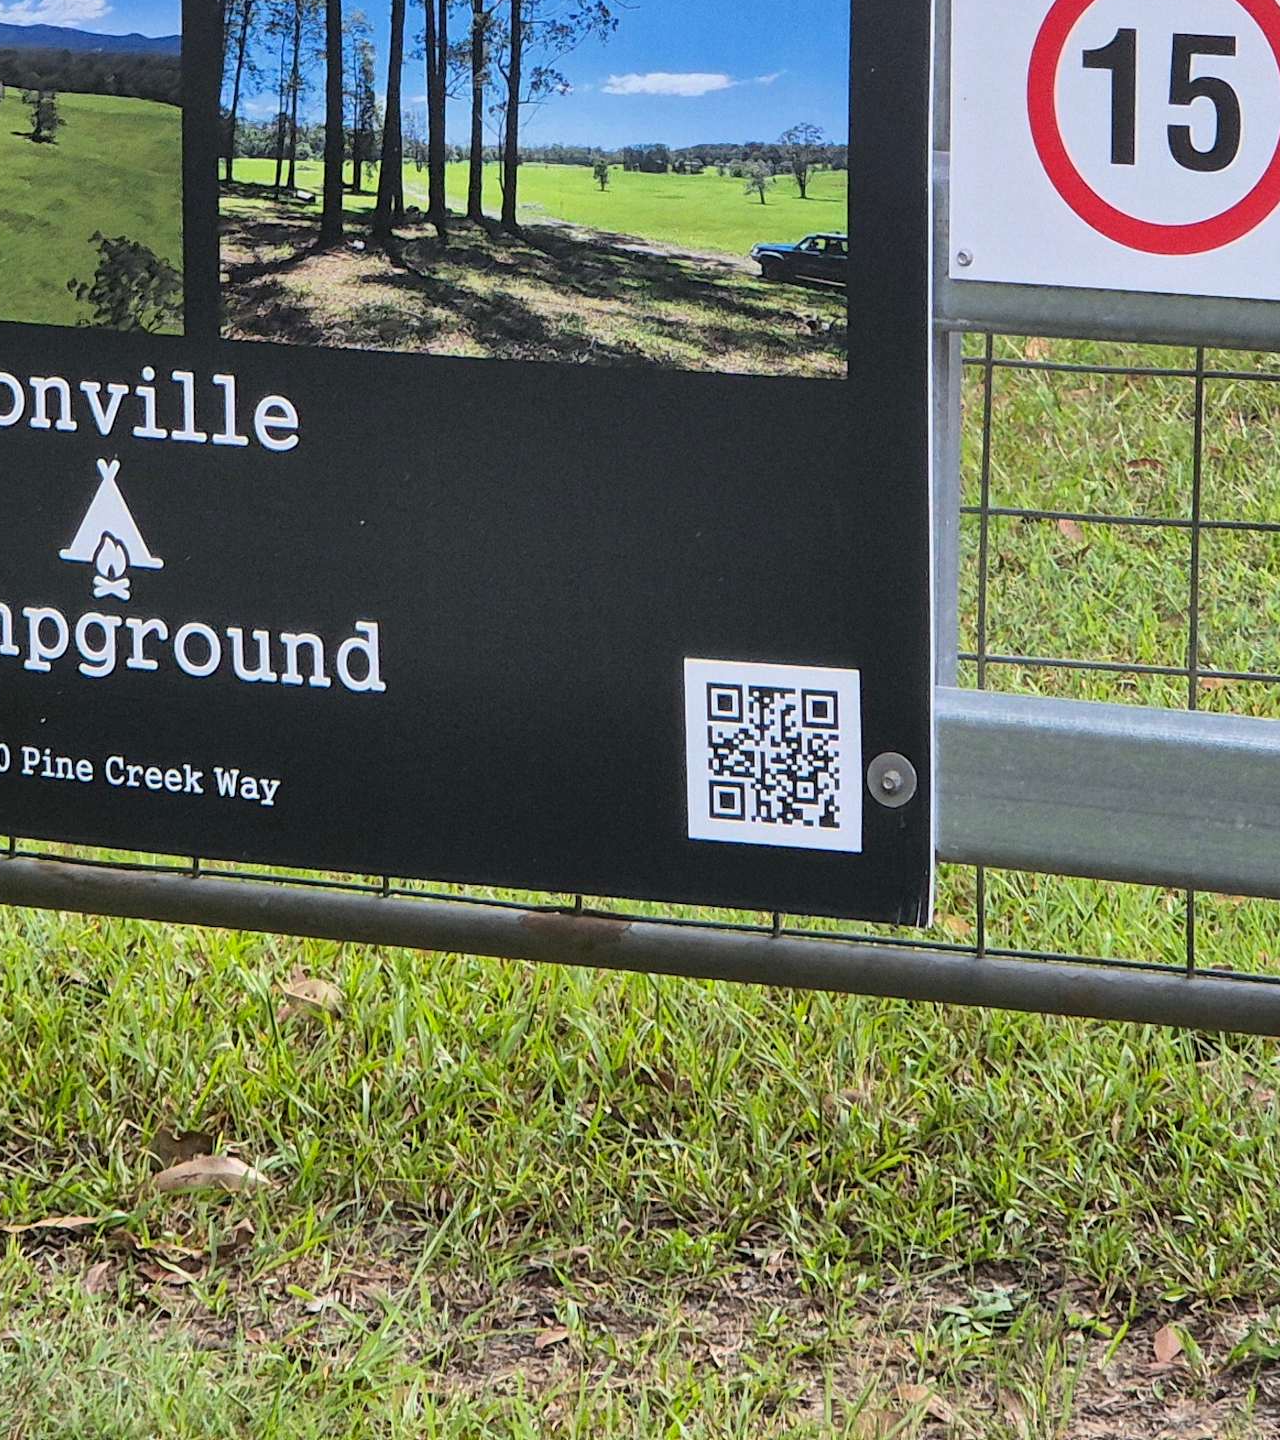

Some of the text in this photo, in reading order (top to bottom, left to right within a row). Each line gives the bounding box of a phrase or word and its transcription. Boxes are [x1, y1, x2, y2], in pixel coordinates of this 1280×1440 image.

[1081, 28, 1242, 172] 15
[21, 745, 94, 782] Pine
[105, 755, 204, 794] Creek
[213, 766, 282, 807] Way
